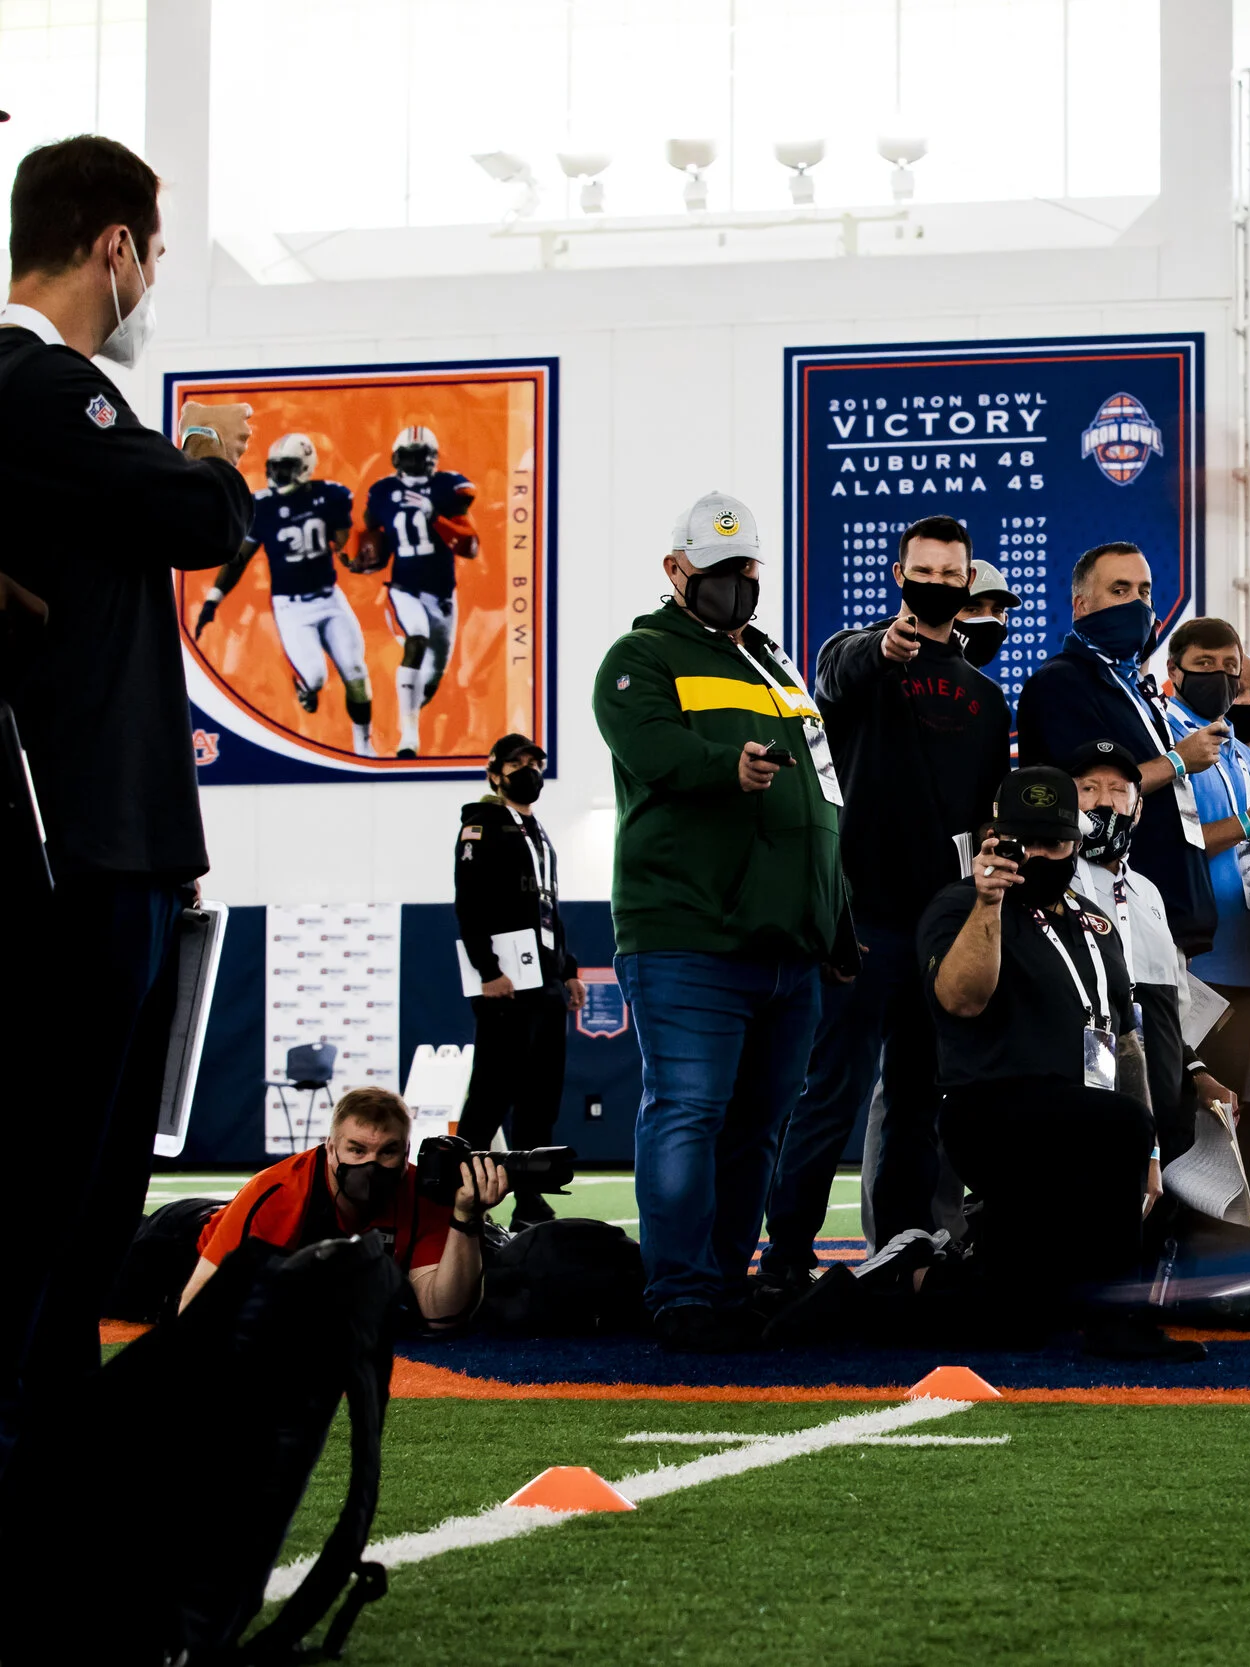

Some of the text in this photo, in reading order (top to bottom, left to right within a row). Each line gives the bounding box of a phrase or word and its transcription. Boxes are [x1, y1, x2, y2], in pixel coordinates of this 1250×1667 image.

[829, 392, 1047, 411] 2019 IRON BOWL
[833, 408, 1041, 438] VICTORY
[1084, 422, 1160, 453] IRON BOWL
[840, 451, 1034, 473] AUBURN 48
[831, 474, 1044, 496] ALABAMA 45
[1001, 516, 1047, 529] 1997
[393, 510, 435, 557] 11
[1000, 533, 1047, 545] 2000
[277, 518, 327, 562] 30
[843, 538, 888, 550] 1895
[843, 555, 888, 567] 1900
[1000, 549, 1046, 562] 2002
[512, 470, 529, 666] IRON BOWL
[1000, 566, 1047, 578] 2003
[843, 571, 885, 583] 1901
[843, 587, 887, 599] 1902
[1010, 583, 1047, 594] 004
[843, 604, 887, 616] 1904
[1006, 599, 1047, 611] 05
[1006, 616, 1047, 628] 006
[1000, 649, 1048, 661] 2010
[1000, 666, 1033, 678] 201
[1001, 683, 1023, 695] 20
[901, 677, 981, 715] CHIEFS
